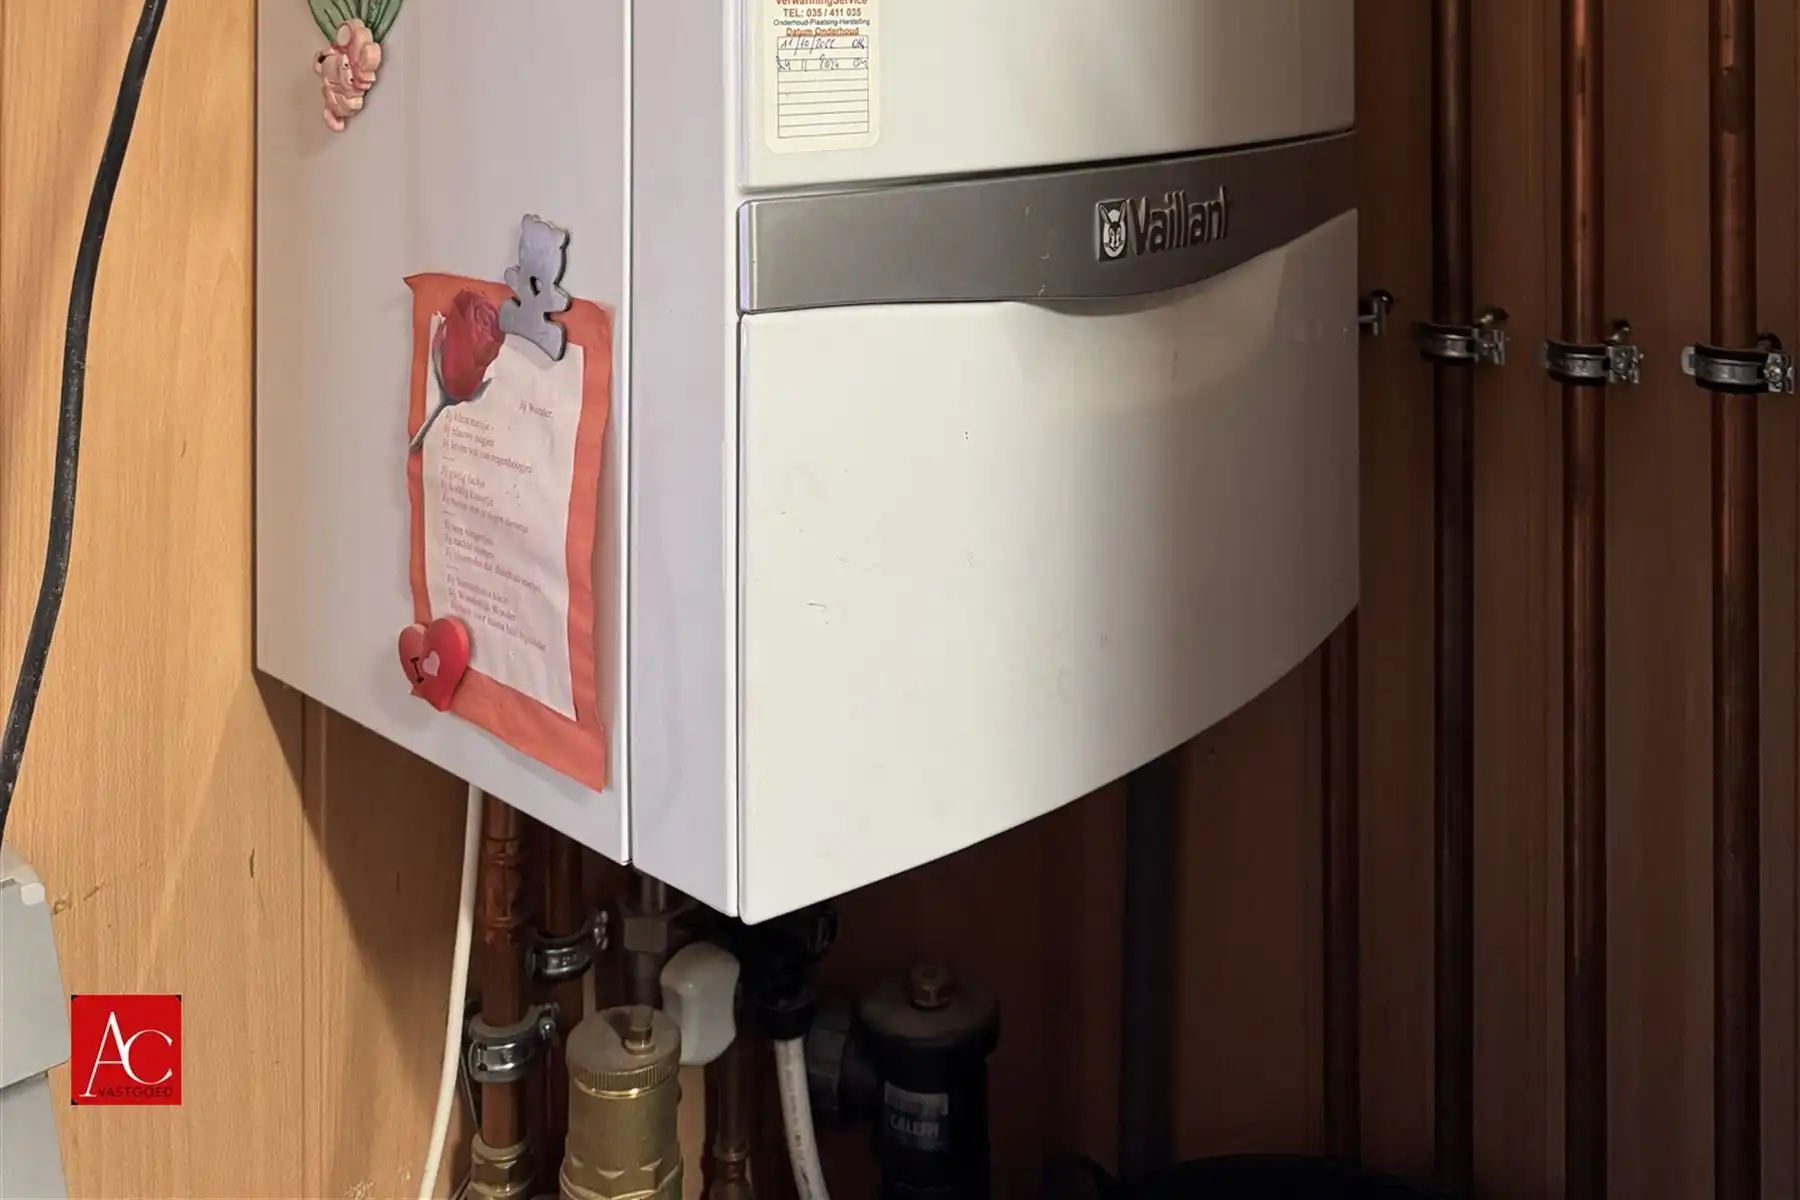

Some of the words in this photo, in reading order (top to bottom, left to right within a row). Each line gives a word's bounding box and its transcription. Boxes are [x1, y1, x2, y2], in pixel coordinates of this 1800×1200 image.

[783, 8, 804, 17] TEL:
[806, 8, 822, 17] 035
[829, 8, 844, 17] 411
[846, 8, 862, 17] 035
[815, 27, 860, 37] Onderhoud
[1126, 184, 1228, 256] Vaillant
